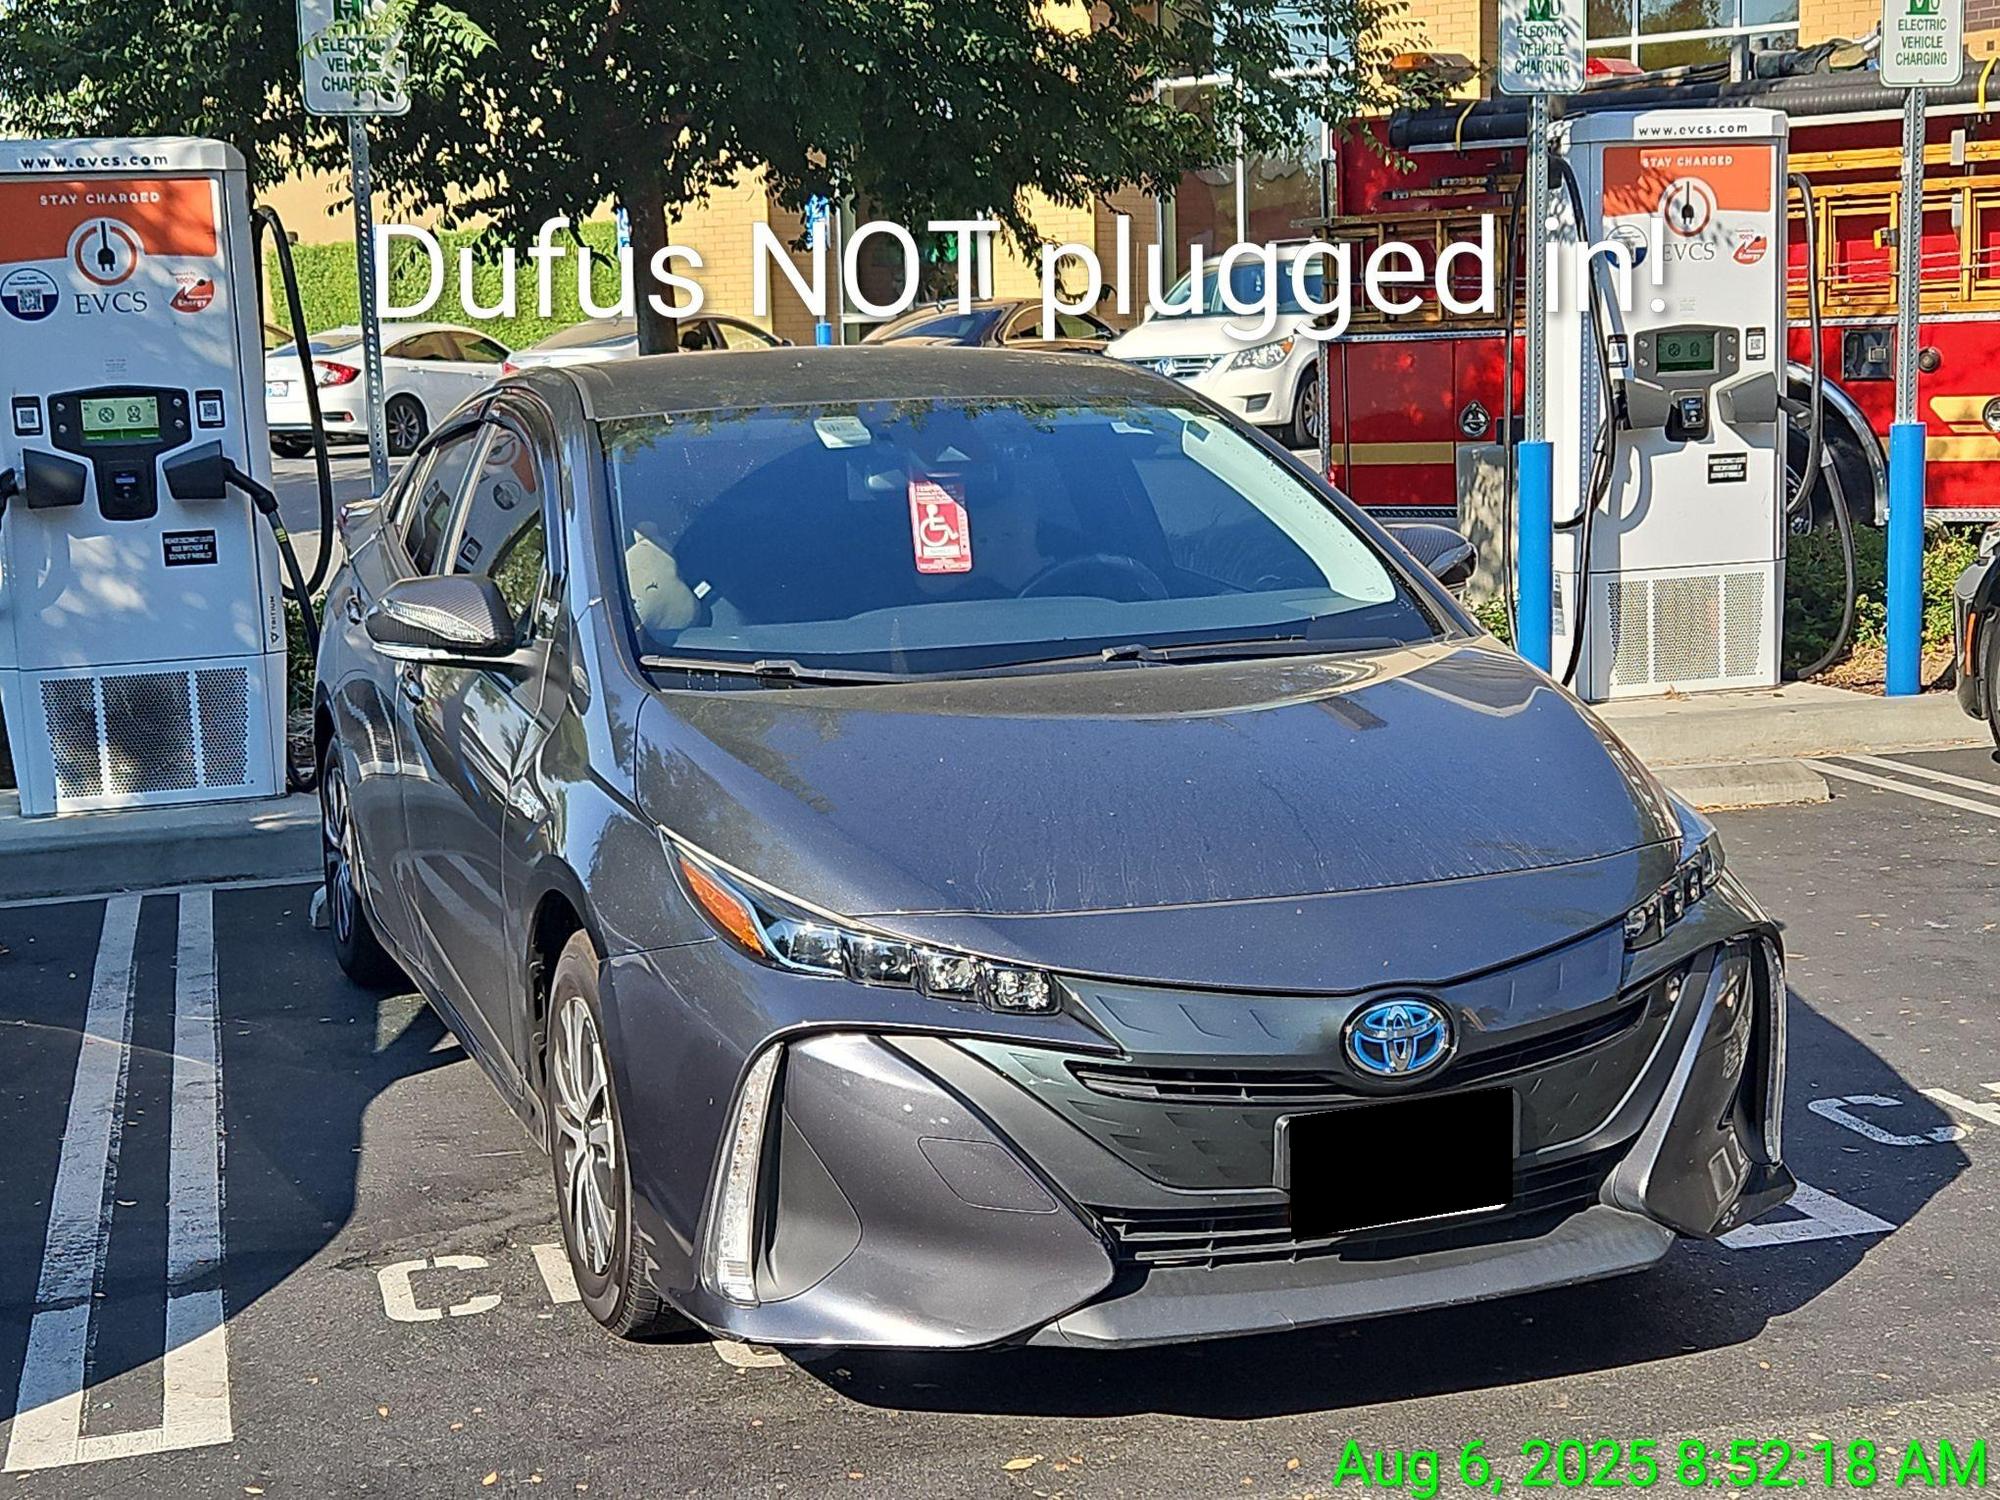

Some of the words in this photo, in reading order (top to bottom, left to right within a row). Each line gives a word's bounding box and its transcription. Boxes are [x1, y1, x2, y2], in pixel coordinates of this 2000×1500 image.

[1516, 25, 1569, 38] ELECTRIC
[1898, 19, 1947, 31] ELECTRIC
[320, 37, 386, 53] ELECT
[1520, 43, 1565, 56] VEHICLE
[1901, 36, 1943, 49] VEHICLE
[1896, 52, 1947, 66] CHARGING
[1514, 59, 1570, 74] CHARGING
[321, 75, 391, 93] CHARG
[1638, 124, 1748, 137] www.evcs.com
[20, 154, 169, 169] www.evcs.com
[1642, 157, 1672, 168] STAY
[1676, 154, 1734, 167] CHARGED
[39, 193, 79, 206] STAY
[85, 191, 161, 205] CHARGED
[1663, 241, 1716, 262] EVCS
[74, 290, 149, 315] EVCS
